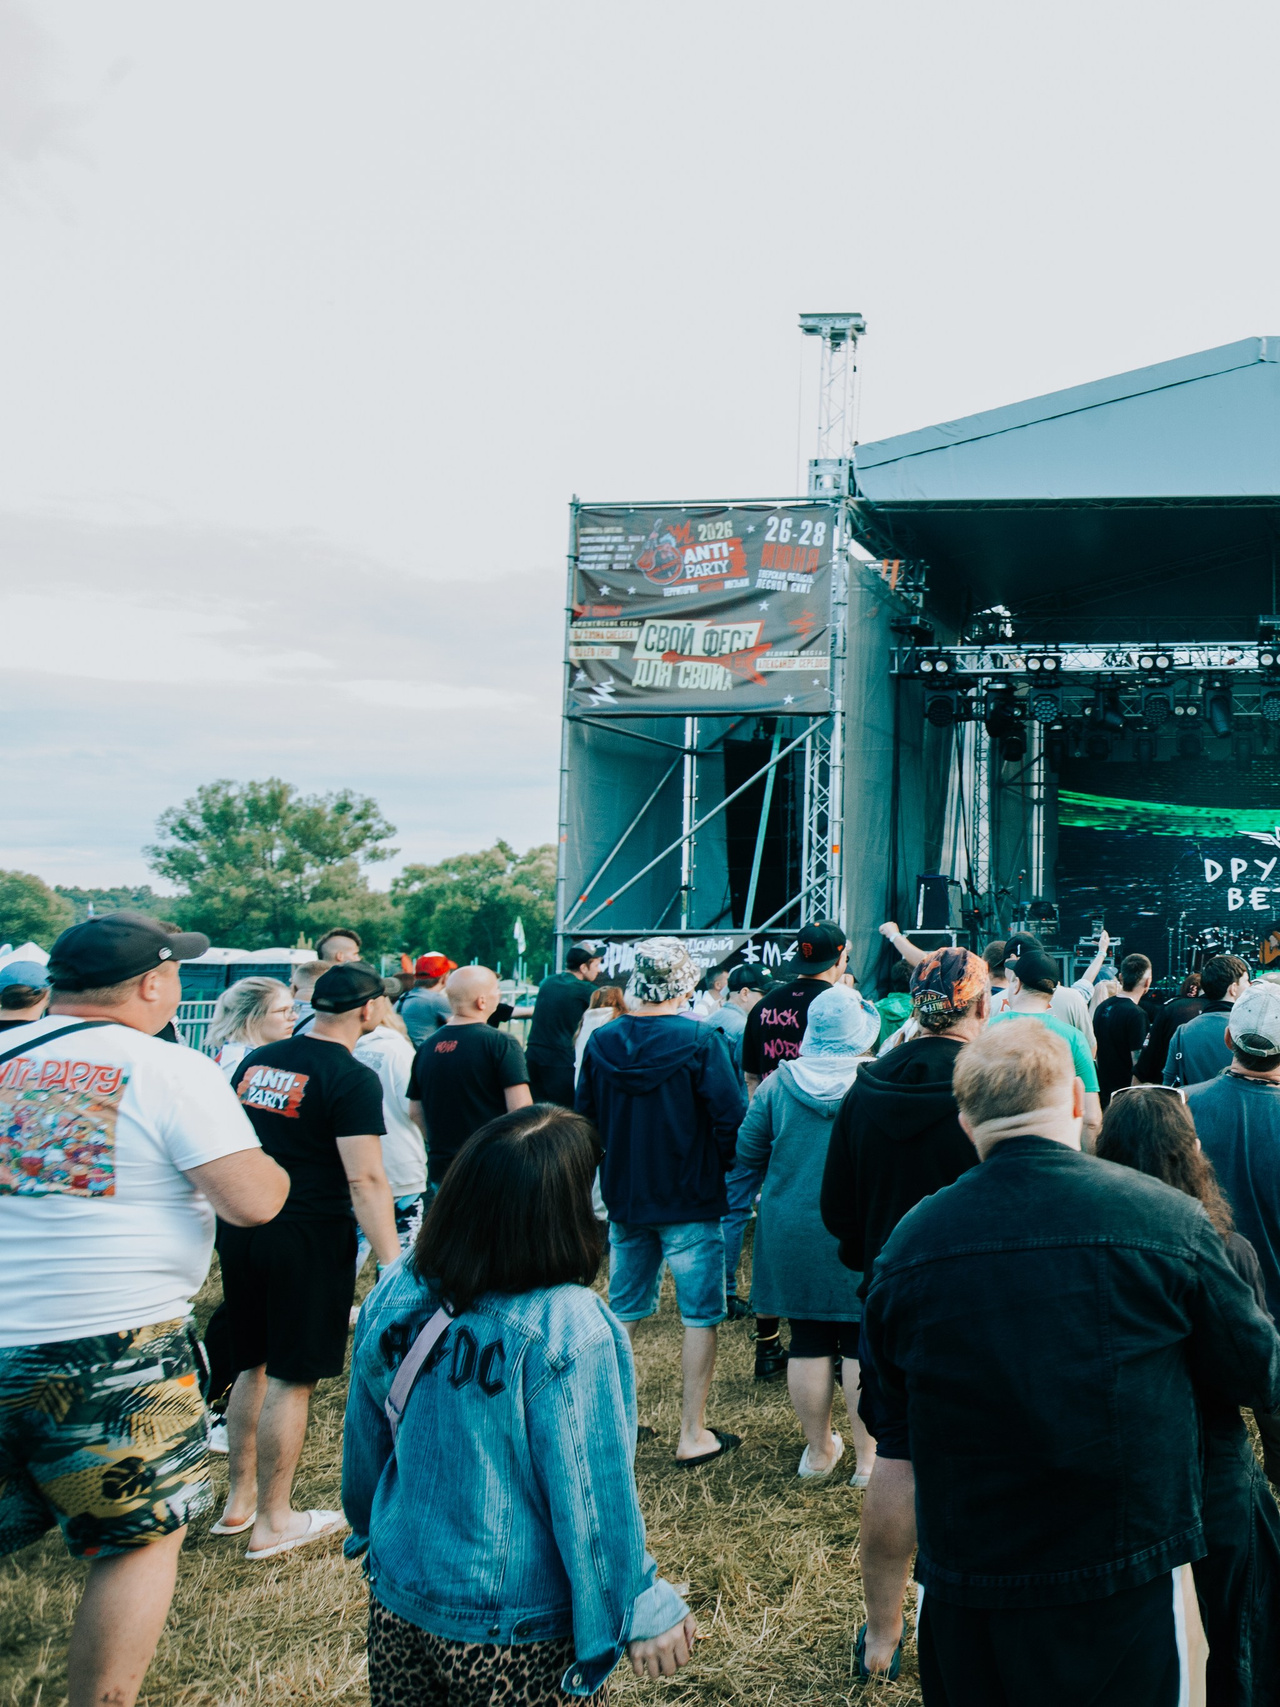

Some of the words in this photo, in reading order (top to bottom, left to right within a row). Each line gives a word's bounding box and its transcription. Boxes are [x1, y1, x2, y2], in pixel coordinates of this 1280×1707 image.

[697, 520, 734, 541] 2026
[765, 516, 827, 547] 26-28
[684, 541, 735, 564] ANTI-
[761, 543, 820, 573] ИЮНЯ
[685, 560, 730, 579] PARTY
[645, 622, 694, 655] СВОЙ
[702, 628, 753, 657] ФЕСТ
[632, 659, 672, 687] ДЛЯ
[760, 1007, 799, 1029] FUCK
[249, 1069, 300, 1093] ANTI-
[246, 1086, 289, 1110] PARTY
